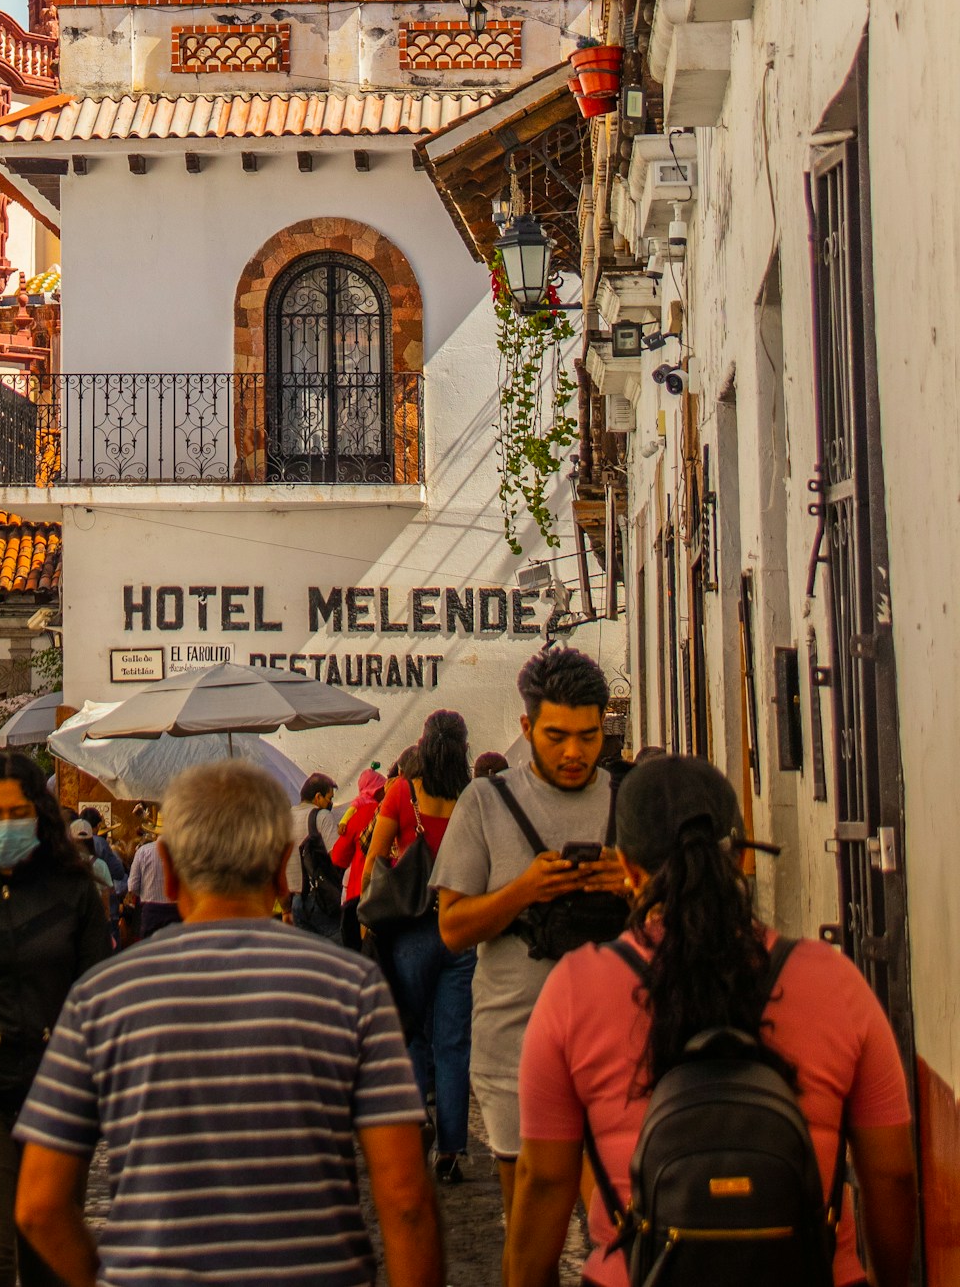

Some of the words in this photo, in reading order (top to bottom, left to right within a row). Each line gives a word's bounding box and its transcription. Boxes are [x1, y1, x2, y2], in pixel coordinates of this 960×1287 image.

[124, 586, 283, 631] HOTEL
[171, 646, 183, 662] EL
[187, 646, 231, 663] FAROLITO
